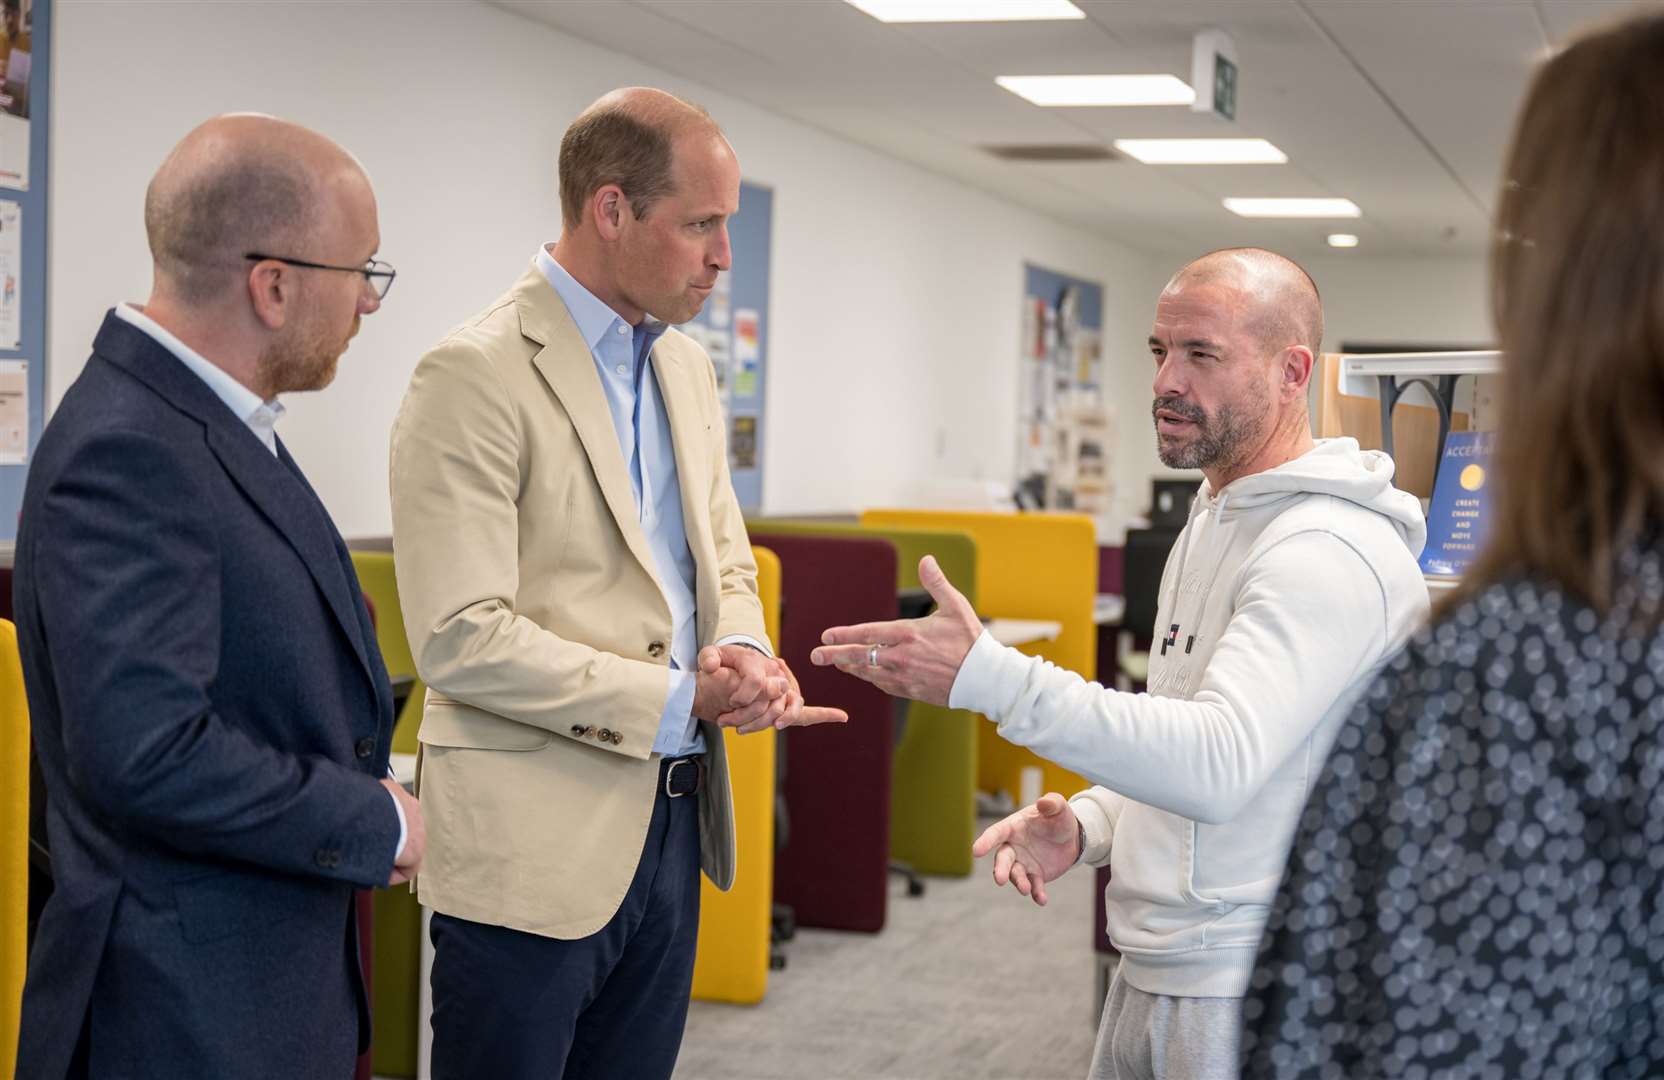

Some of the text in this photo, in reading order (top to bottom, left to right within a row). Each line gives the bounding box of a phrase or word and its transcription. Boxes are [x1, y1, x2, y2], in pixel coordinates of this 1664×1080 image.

[1455, 498, 1480, 507] CREATE
[1455, 520, 1471, 528] AND
[1451, 531, 1472, 540] MOVE
